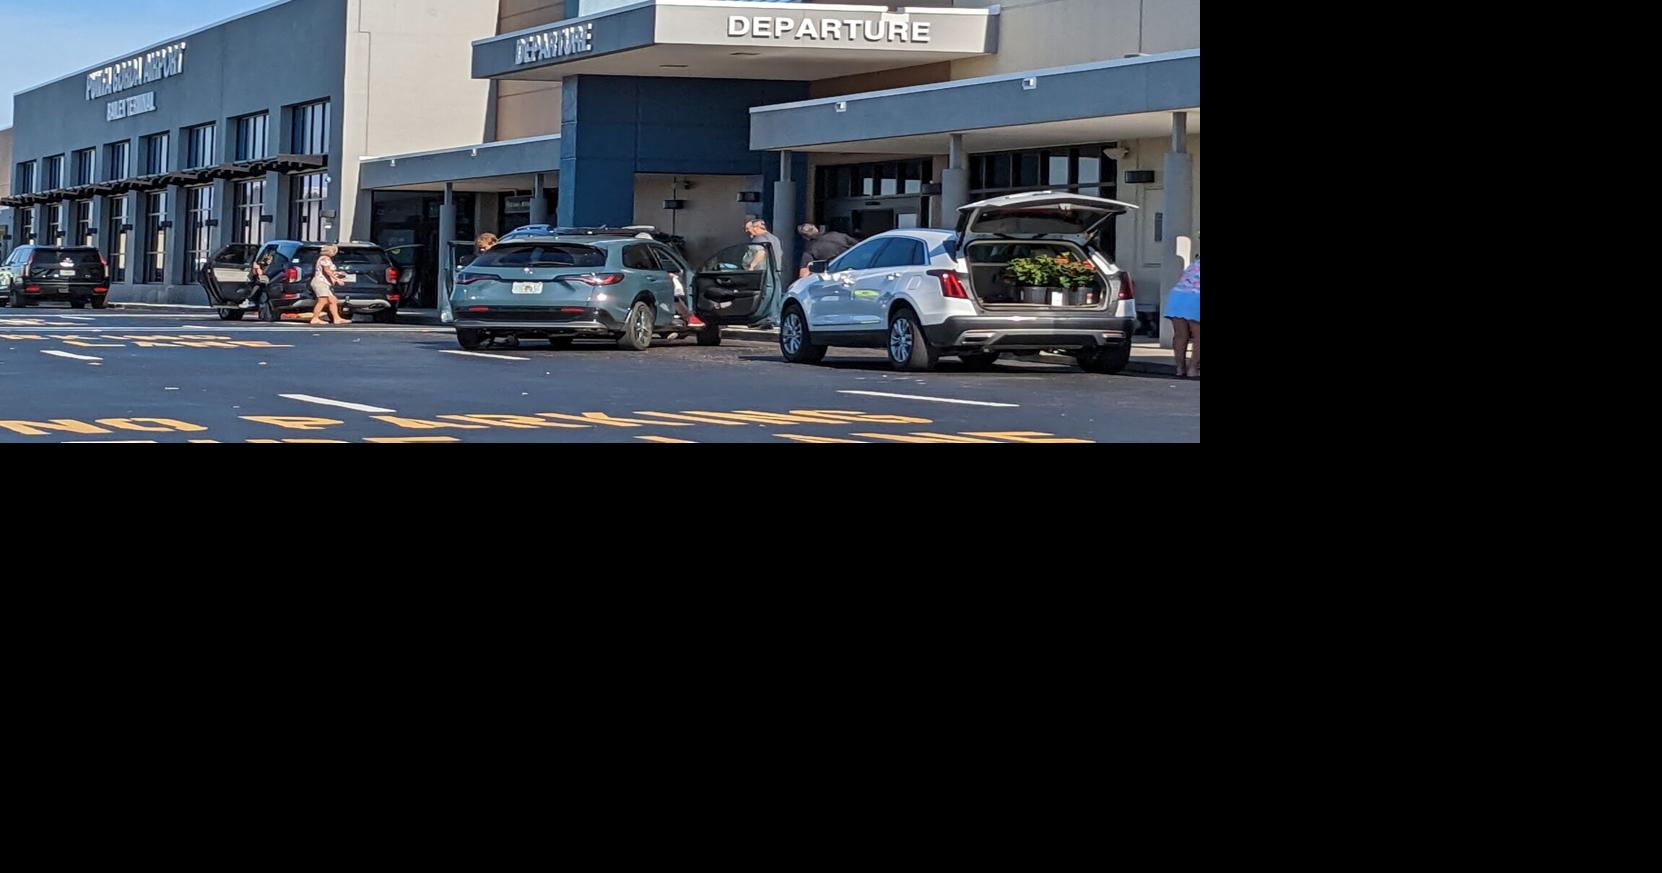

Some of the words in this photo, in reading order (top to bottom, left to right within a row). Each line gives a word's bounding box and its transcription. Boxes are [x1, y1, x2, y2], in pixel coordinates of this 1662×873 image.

[728, 15, 931, 43] DEPARTURE
[515, 23, 593, 65] DEPARTURE
[0, 417, 209, 436] NO
[237, 409, 935, 430] PARKING
